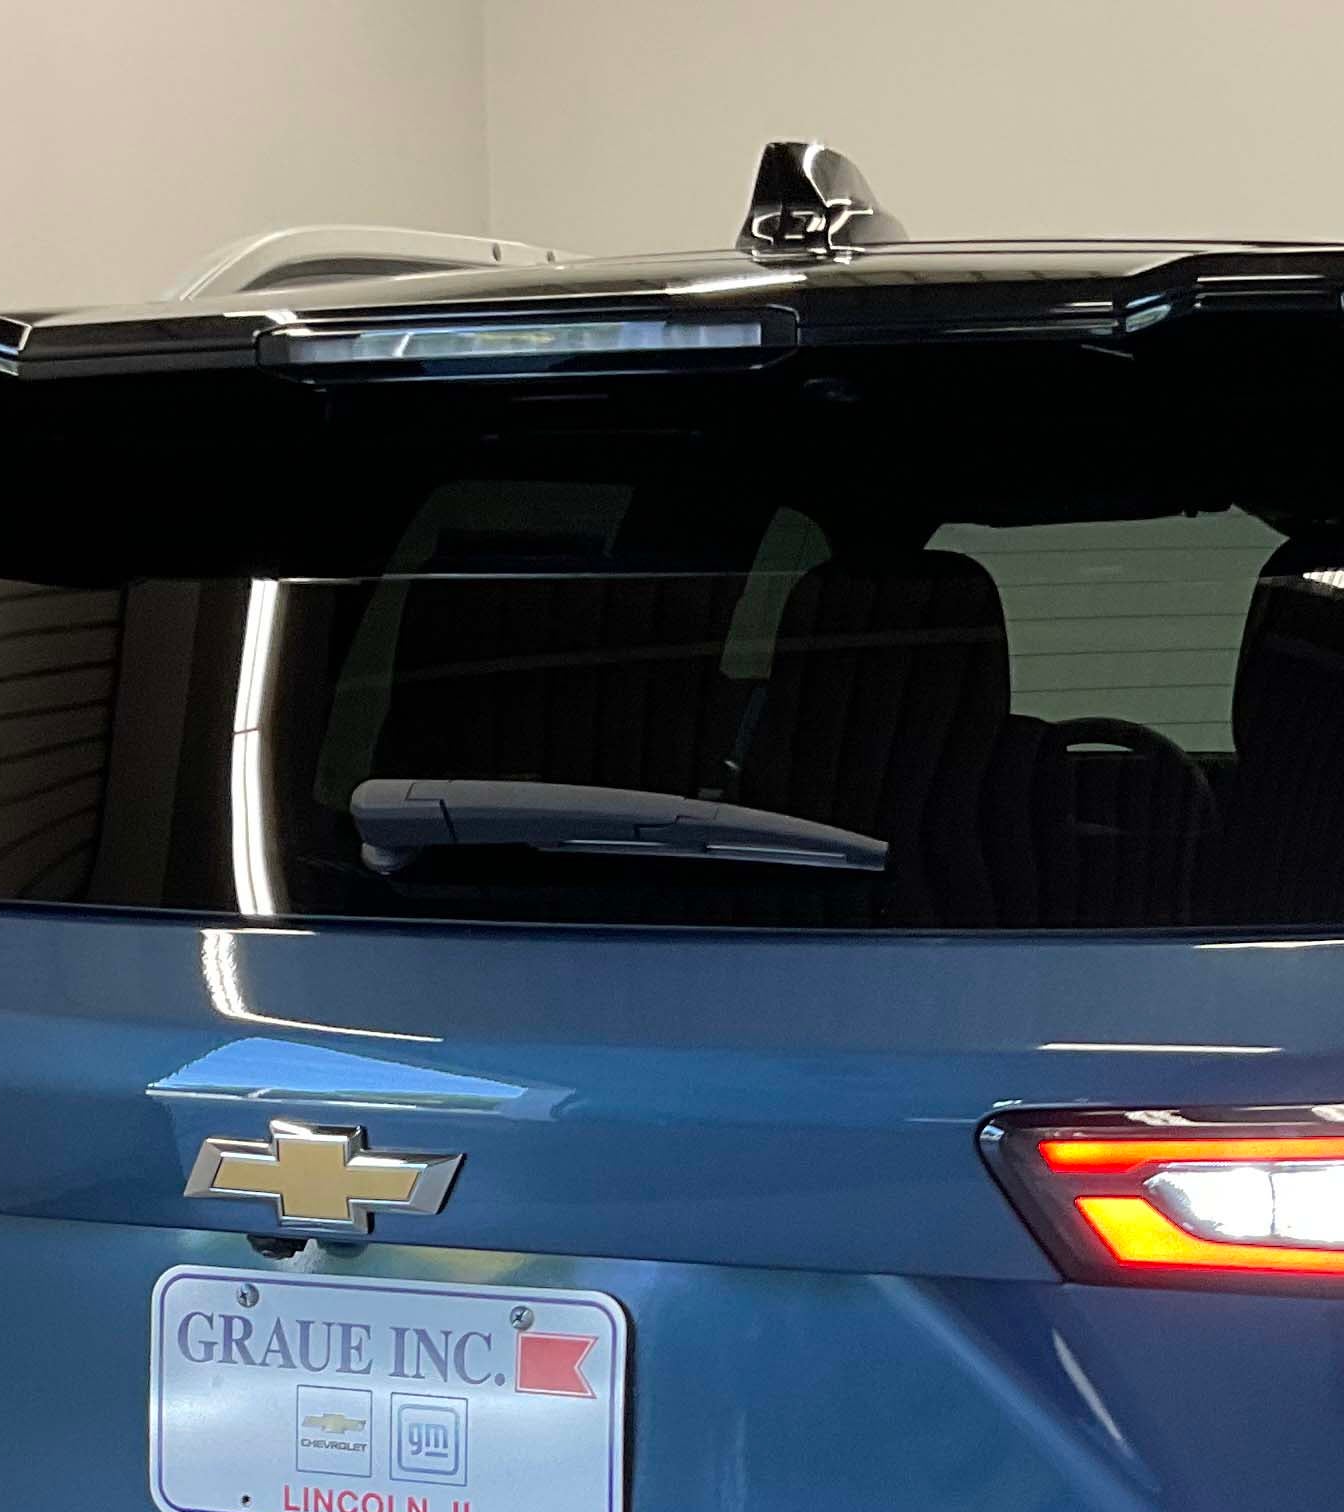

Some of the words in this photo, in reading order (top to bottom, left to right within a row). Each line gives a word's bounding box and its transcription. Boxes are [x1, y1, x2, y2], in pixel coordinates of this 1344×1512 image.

[177, 1311, 373, 1375] GRAUE
[388, 1326, 505, 1386] INC.
[300, 1438, 368, 1452] CHEVROLET
